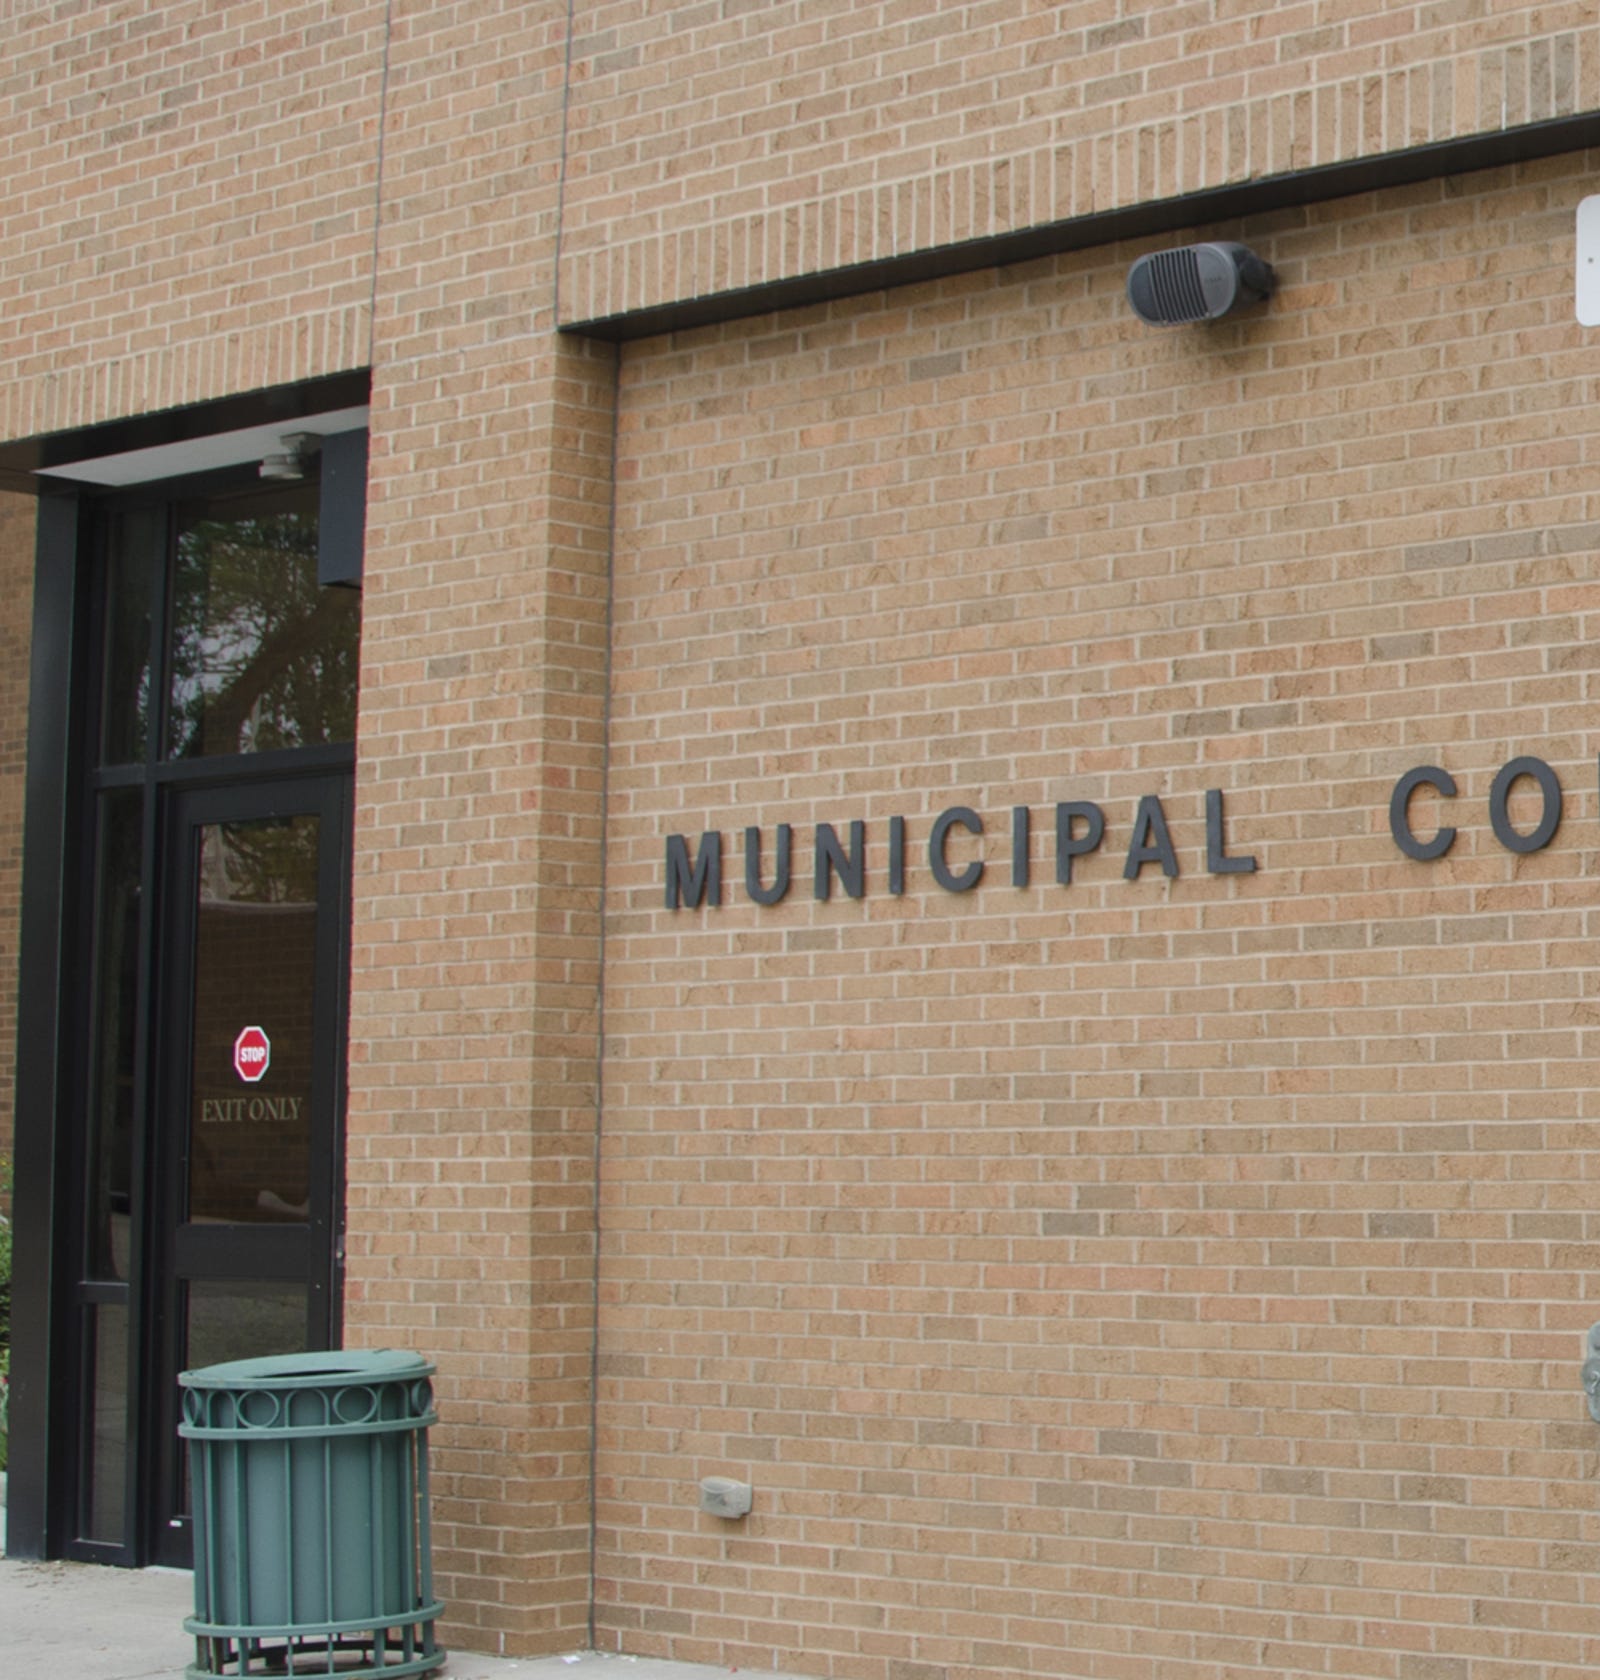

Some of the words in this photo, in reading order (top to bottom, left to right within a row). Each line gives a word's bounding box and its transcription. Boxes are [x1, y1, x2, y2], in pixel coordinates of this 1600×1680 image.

[665, 788, 1258, 910] MUNICIPAL
[240, 1046, 266, 1062] STOP
[201, 1098, 247, 1122] EXIT
[249, 1097, 303, 1121] ONLY
